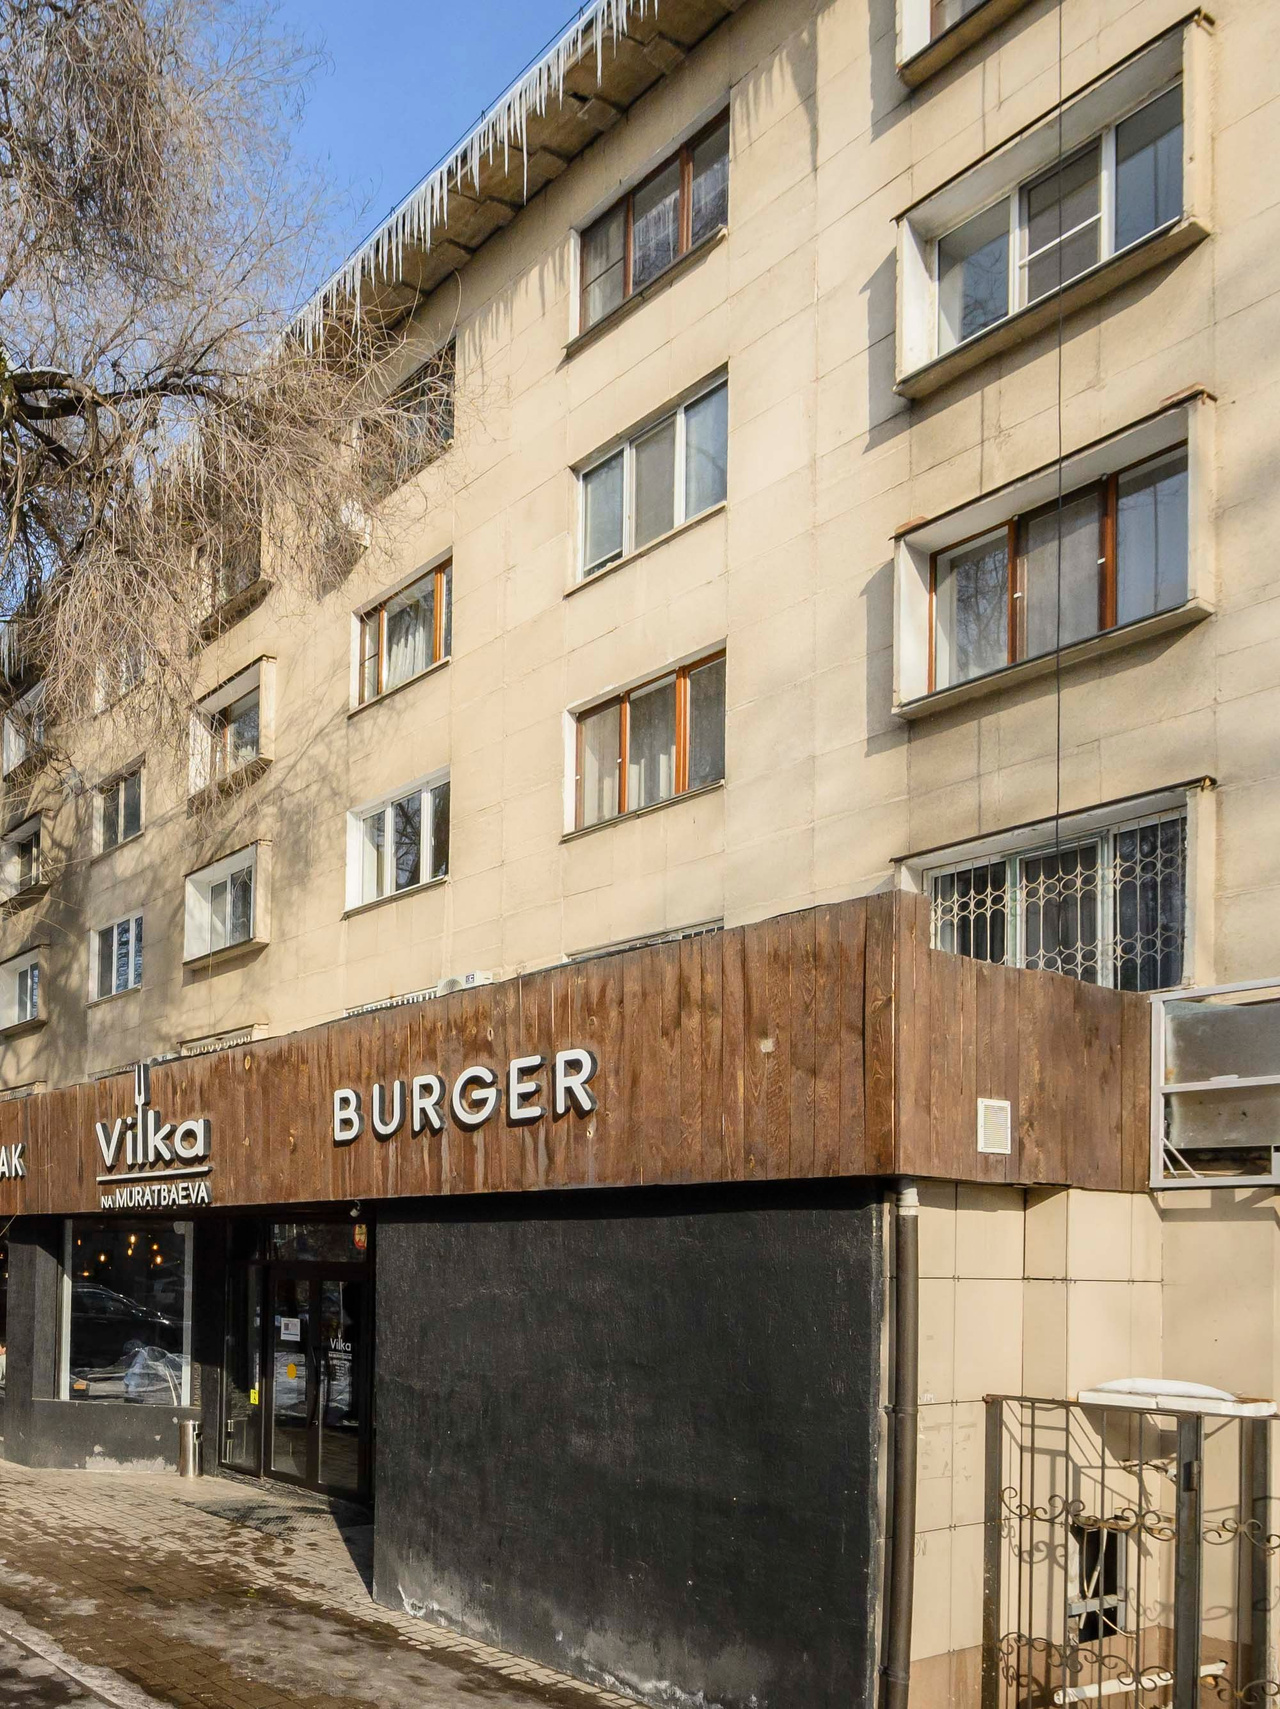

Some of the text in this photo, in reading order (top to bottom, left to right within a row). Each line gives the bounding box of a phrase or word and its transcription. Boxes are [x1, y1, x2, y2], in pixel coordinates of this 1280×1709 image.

[95, 1064, 207, 1168] Vilka
[333, 1048, 593, 1142] BURGER
[101, 1181, 210, 1209] NA MURATBAEVA
[329, 1329, 352, 1352] Vilka
